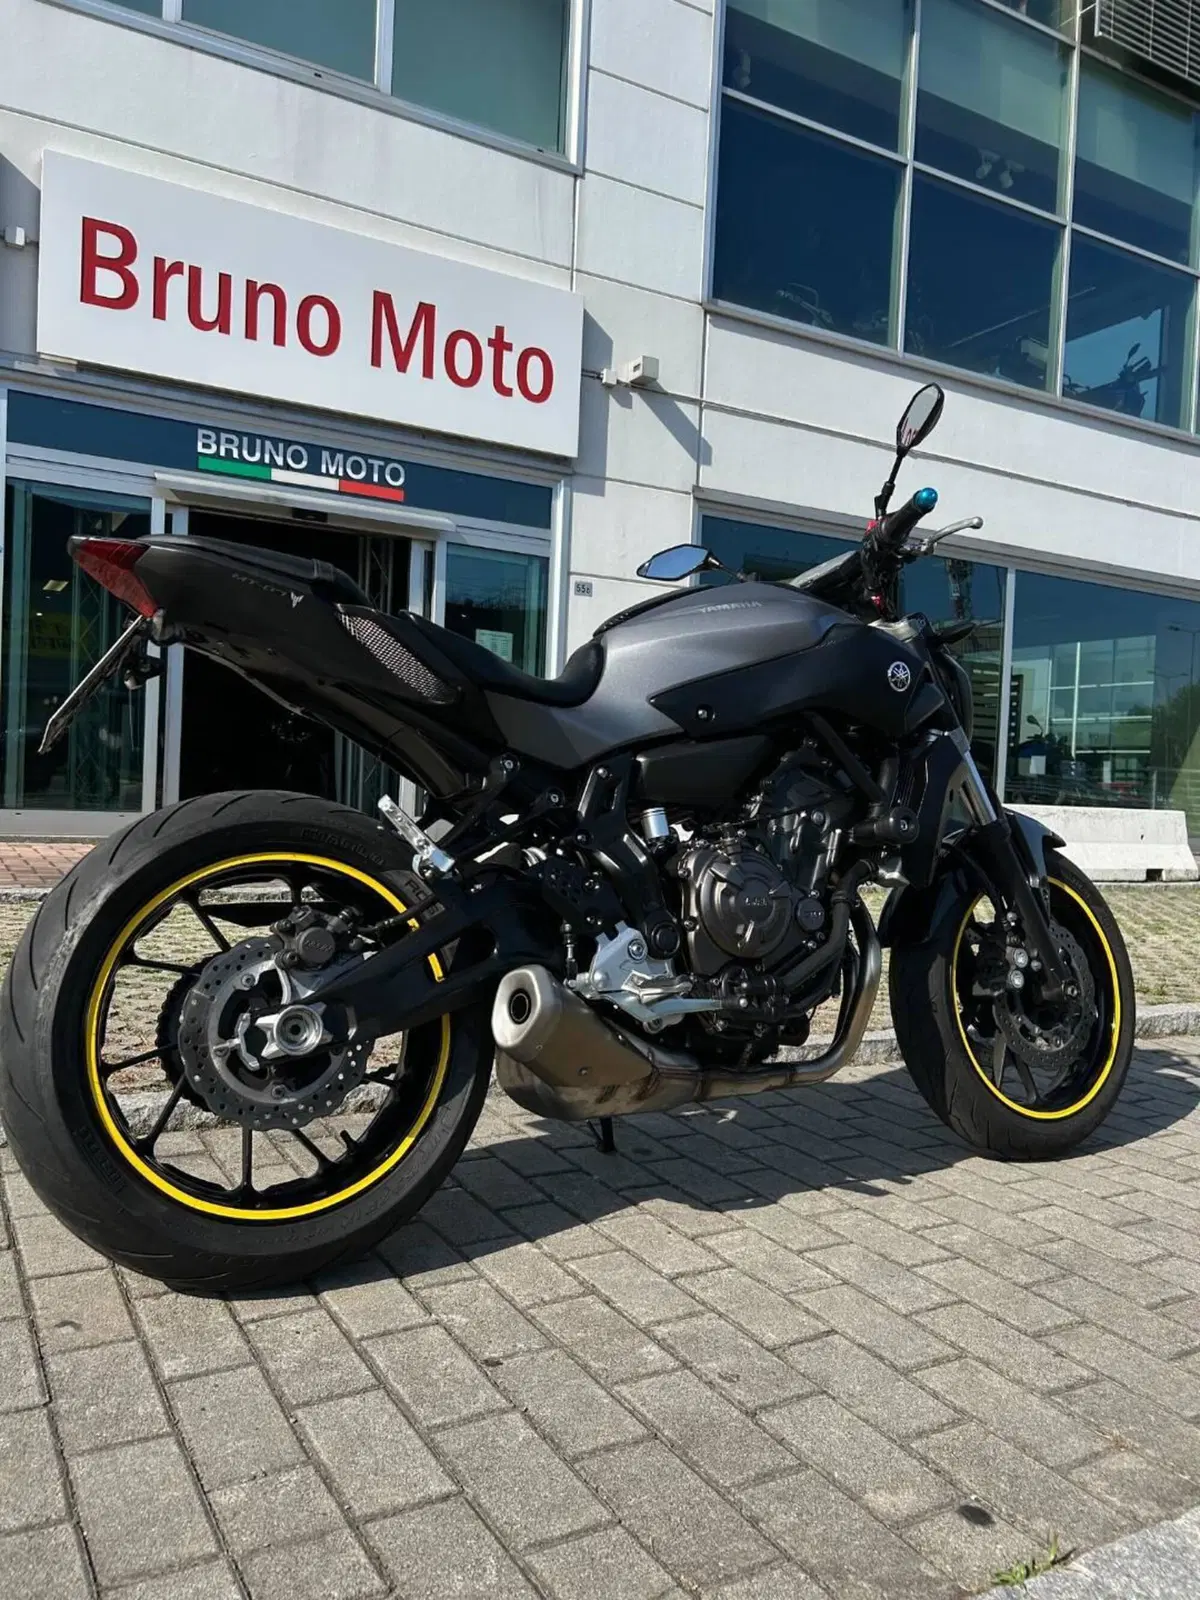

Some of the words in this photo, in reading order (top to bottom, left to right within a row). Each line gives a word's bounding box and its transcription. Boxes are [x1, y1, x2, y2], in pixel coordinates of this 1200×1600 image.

[80, 216, 341, 357] Bruno
[371, 290, 555, 404] Moto
[197, 429, 308, 470] BRUNO
[321, 451, 405, 486] MOTO
